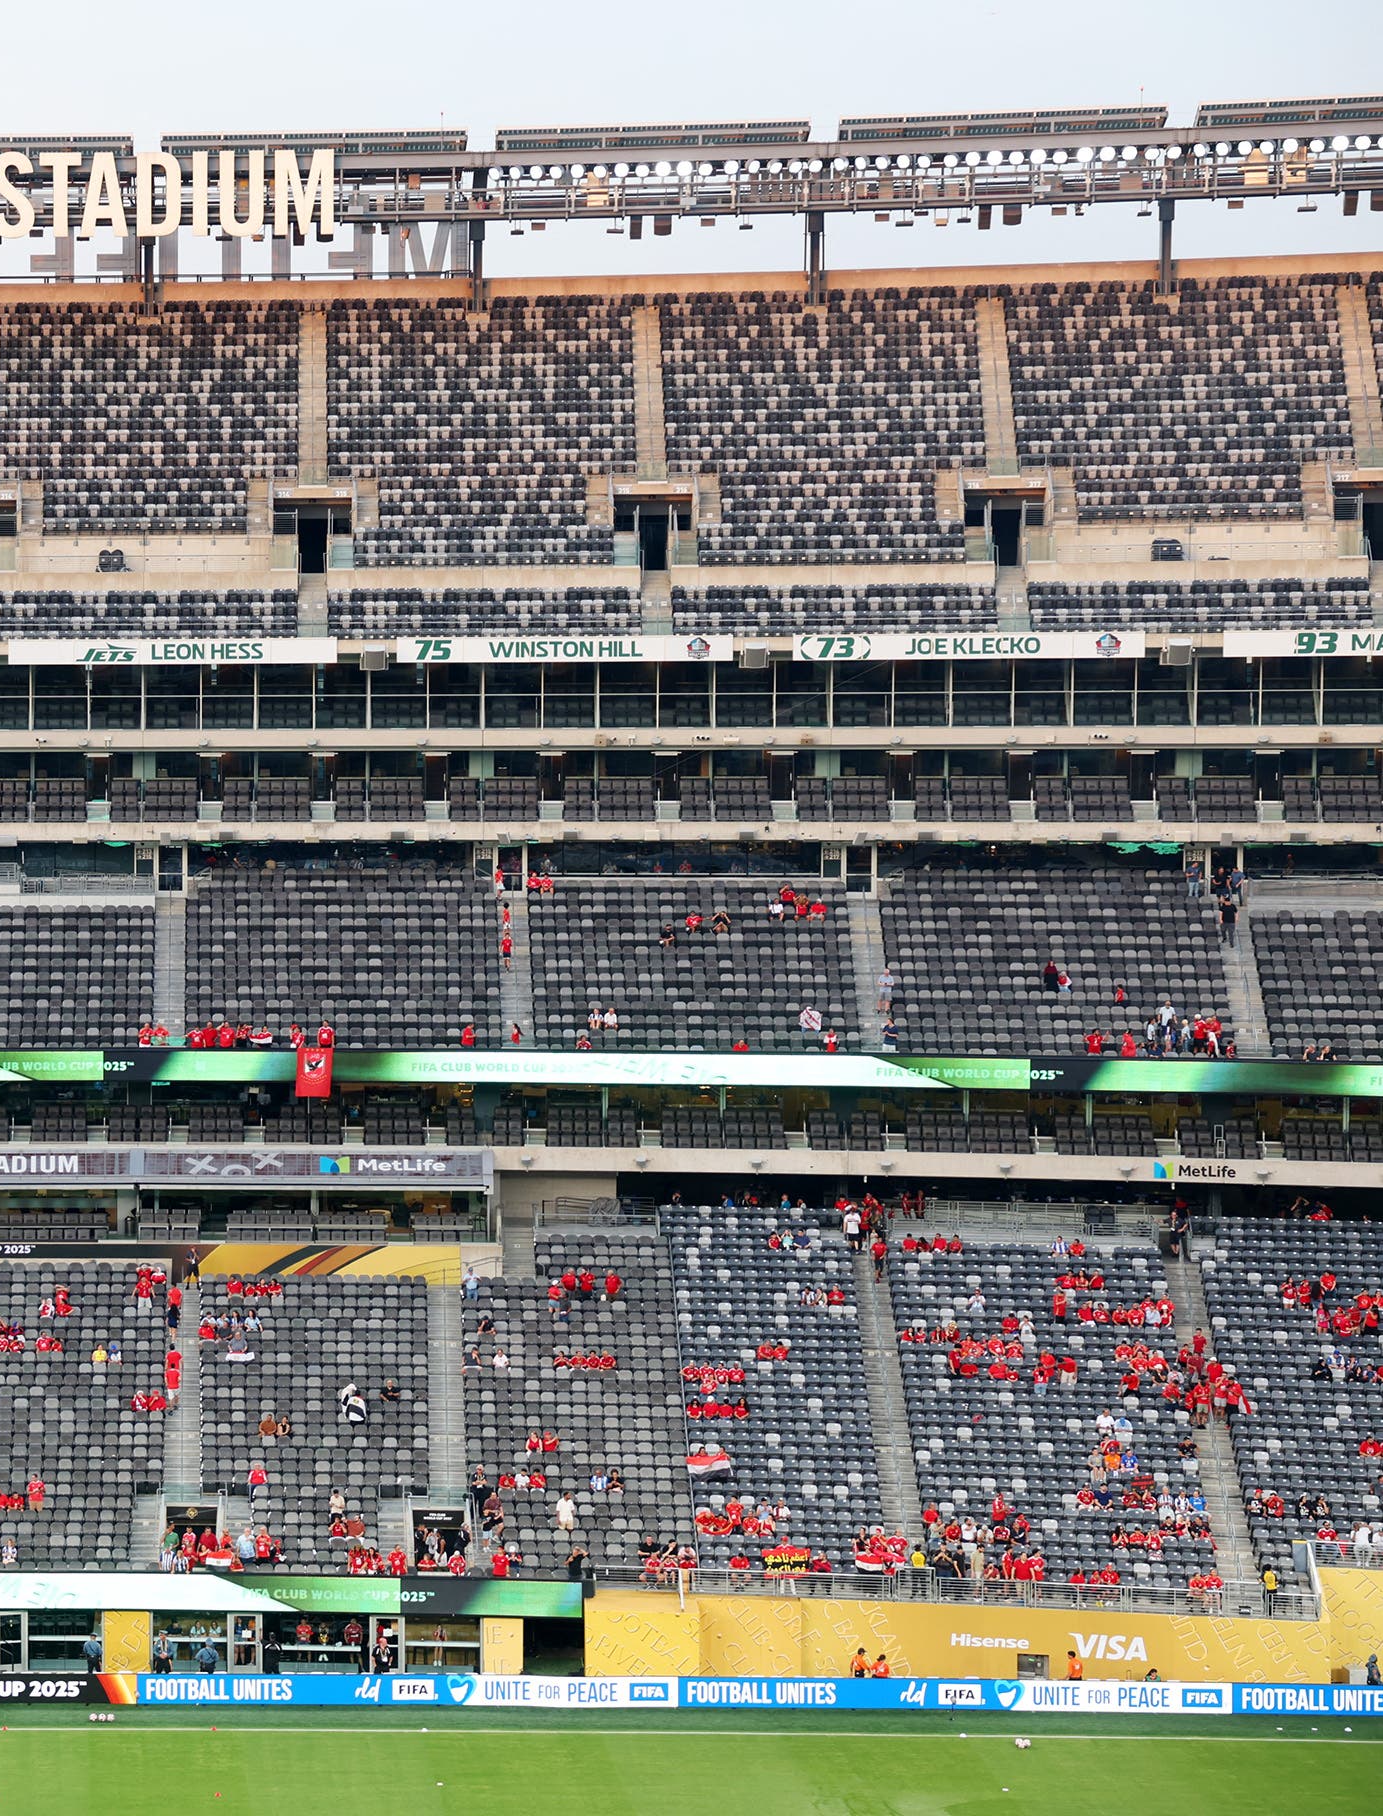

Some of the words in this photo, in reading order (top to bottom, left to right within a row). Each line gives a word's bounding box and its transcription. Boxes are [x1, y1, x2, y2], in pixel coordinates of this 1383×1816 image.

[414, 639, 452, 662] 75
[489, 641, 593, 657] WINSTON
[599, 641, 643, 657] HILL
[815, 636, 855, 659] 73
[905, 638, 947, 654] JOE
[953, 637, 1040, 654] KLECKO
[1294, 632, 1339, 655] 93
[76, 645, 137, 664] JETS
[152, 644, 204, 660] LEON
[211, 643, 263, 659] HESS
[22, 1061, 67, 1072] WORLD
[69, 1061, 95, 1071] CUP
[440, 1062, 471, 1073] CLUB
[474, 1063, 519, 1073] WORLD
[876, 1067, 903, 1078] FIFA
[907, 1068, 940, 1079] CLUB
[943, 1069, 990, 1079] WORLD
[994, 1069, 1020, 1080] CUP
[357, 1159, 447, 1173] MetLife
[1179, 1165, 1235, 1178] MetLife
[272, 1589, 308, 1600] CLUB
[363, 1591, 391, 1602] CUP
[950, 1633, 1029, 1649] Hisense
[1068, 1633, 1147, 1662] VISA
[146, 1679, 229, 1700] FOOTBALL
[234, 1679, 292, 1700] UNITES
[398, 1684, 429, 1696] FIFA
[485, 1681, 530, 1700] UNITE
[539, 1685, 560, 1699] FOR
[568, 1682, 617, 1702] PEACE
[633, 1686, 665, 1699] FIFA
[688, 1682, 772, 1703] FOOTBALL
[776, 1683, 836, 1704] UNITES
[944, 1688, 976, 1701] FIFA
[1033, 1686, 1080, 1705] UNITE
[1088, 1690, 1110, 1704] FOR
[1118, 1687, 1170, 1707] PEACE
[1186, 1691, 1218, 1705] FIFA
[1242, 1688, 1329, 1710] FOOTBALL
